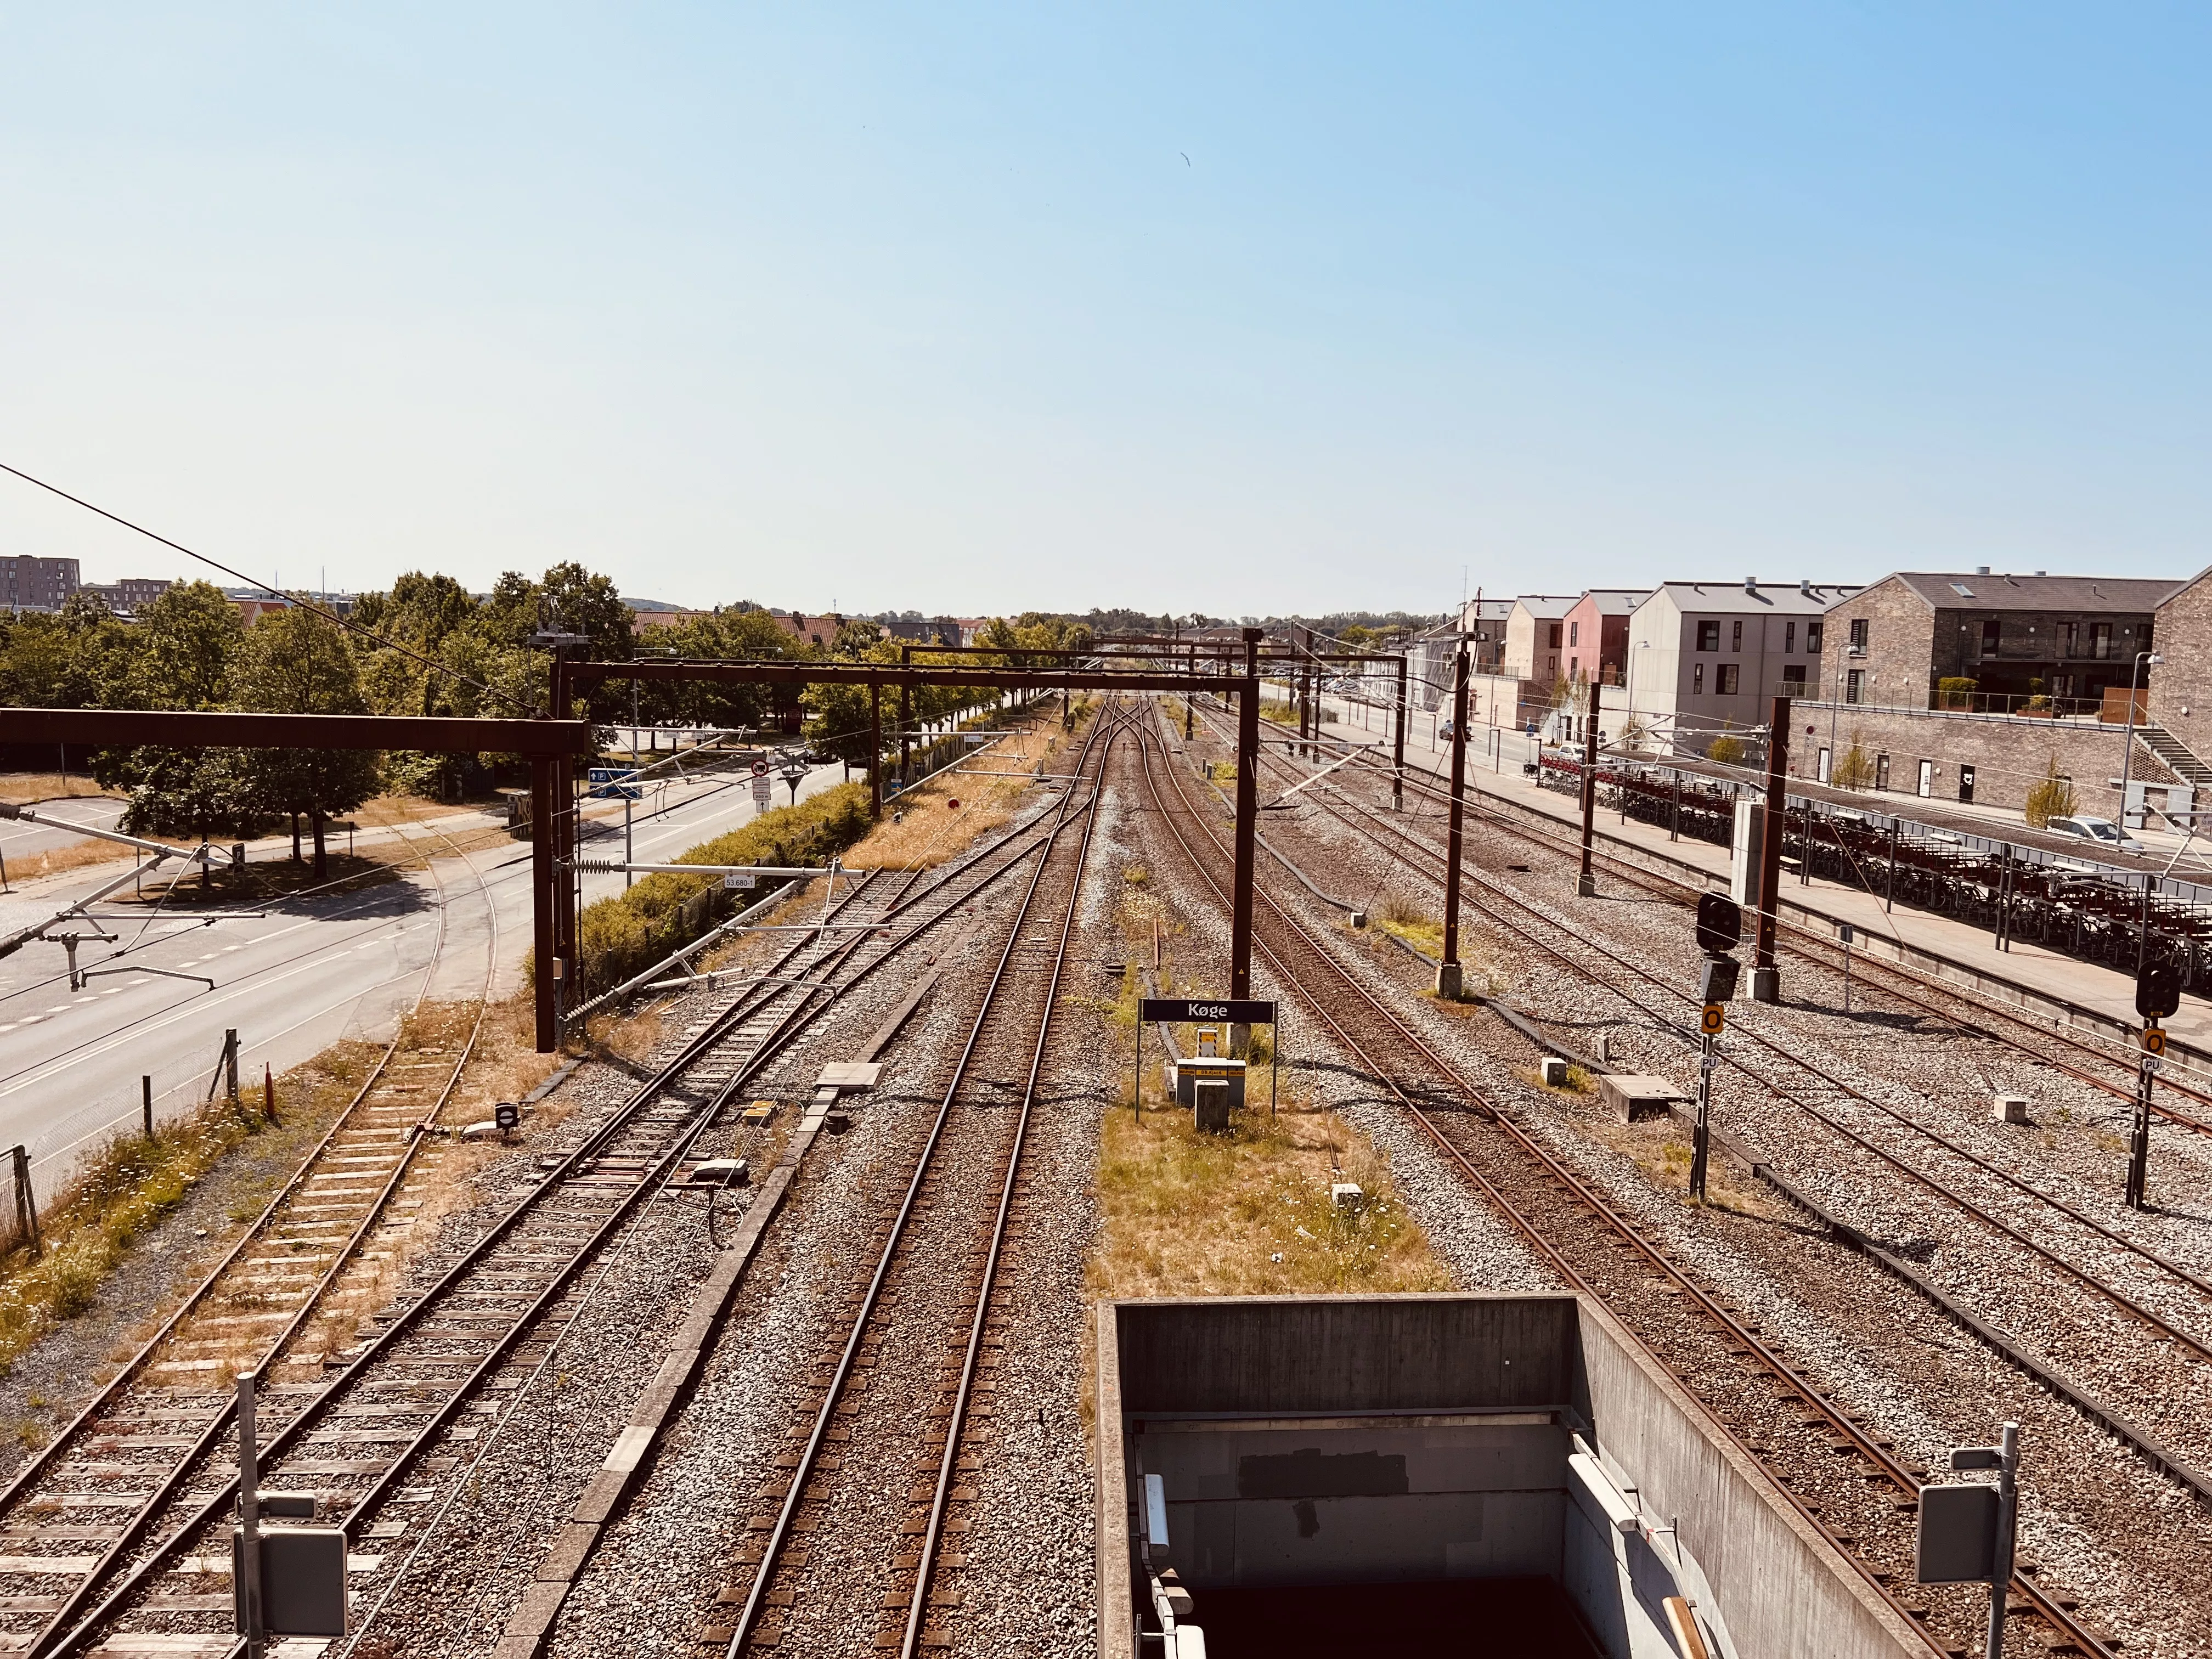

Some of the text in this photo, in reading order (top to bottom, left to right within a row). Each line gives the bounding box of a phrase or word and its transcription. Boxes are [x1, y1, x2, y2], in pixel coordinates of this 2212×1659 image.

[1188, 1003, 1227, 1019] Køge
[1702, 1058, 1717, 1067] PU
[2145, 1061, 2160, 1069] PU
